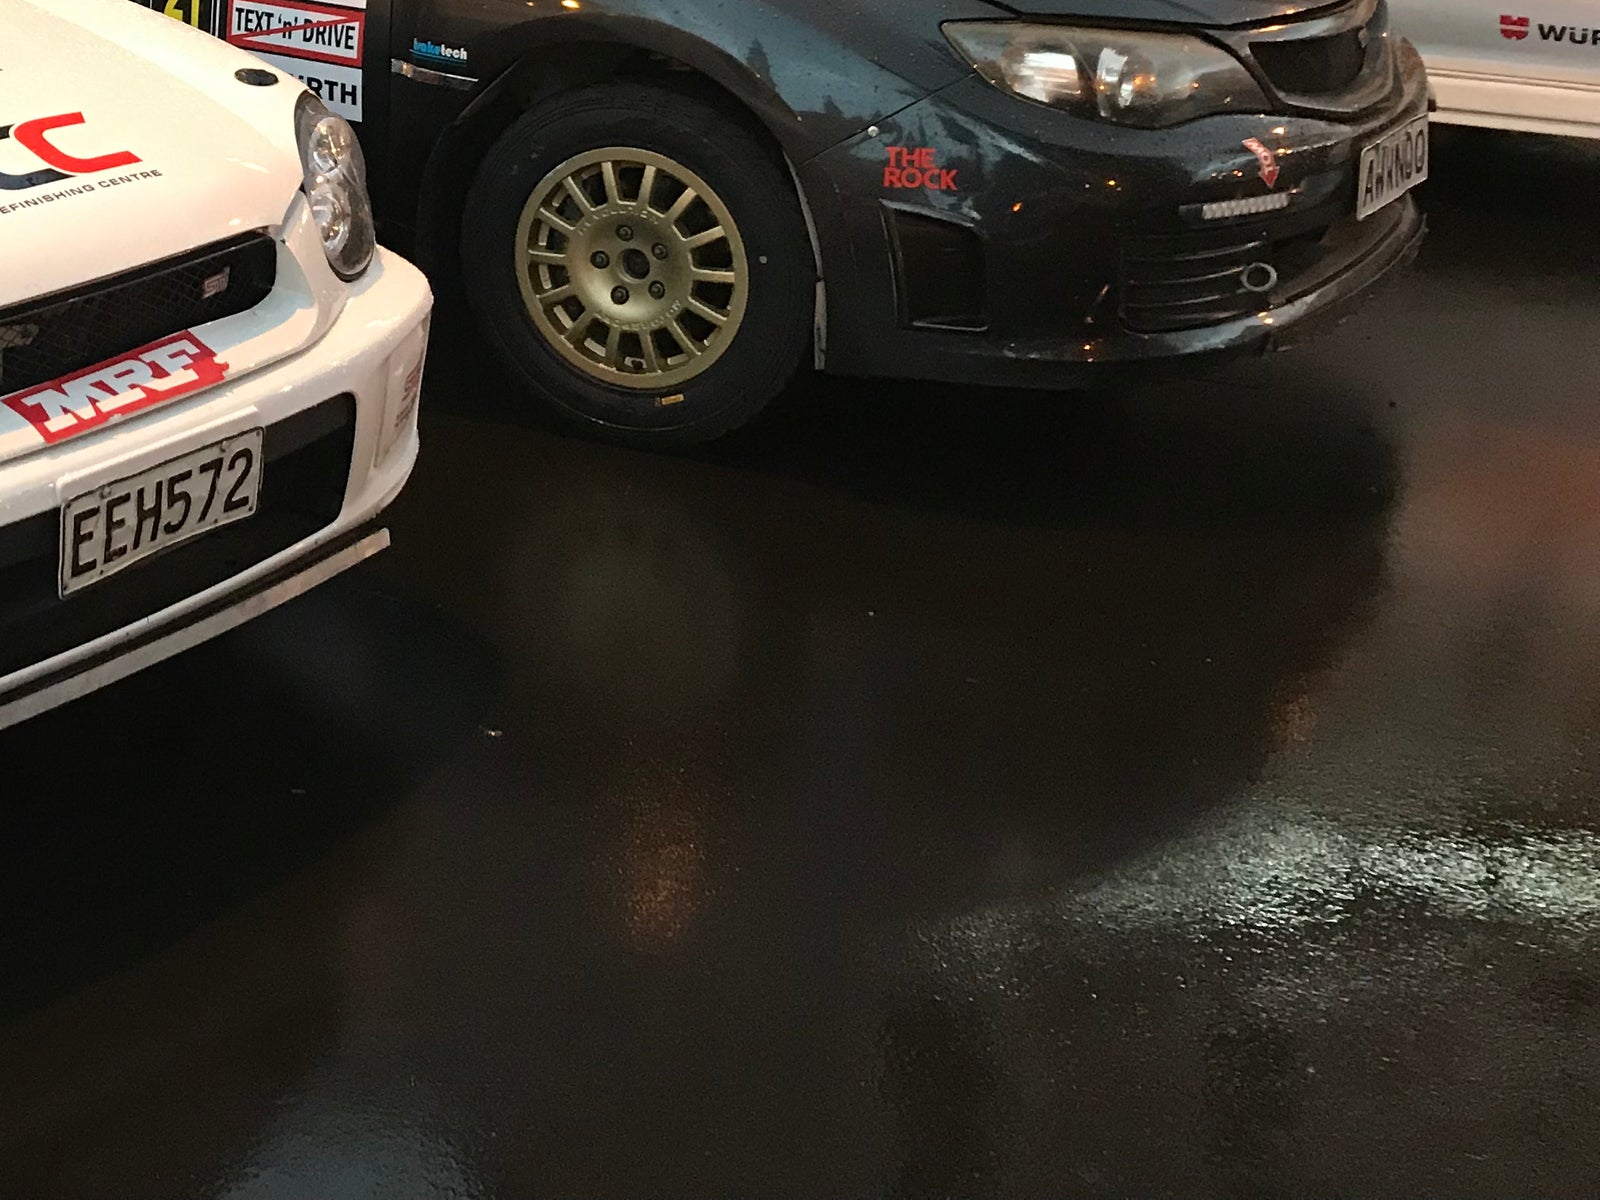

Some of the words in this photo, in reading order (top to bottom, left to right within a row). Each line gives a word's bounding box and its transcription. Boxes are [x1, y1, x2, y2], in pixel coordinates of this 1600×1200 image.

[234, 7, 273, 34] TEXT
[301, 16, 356, 51] DRIVE
[884, 145, 936, 171] THE
[97, 167, 163, 189] CENTRE
[882, 166, 958, 192] ROCK
[24, 337, 202, 434] MRF
[70, 447, 256, 578] EEH572
